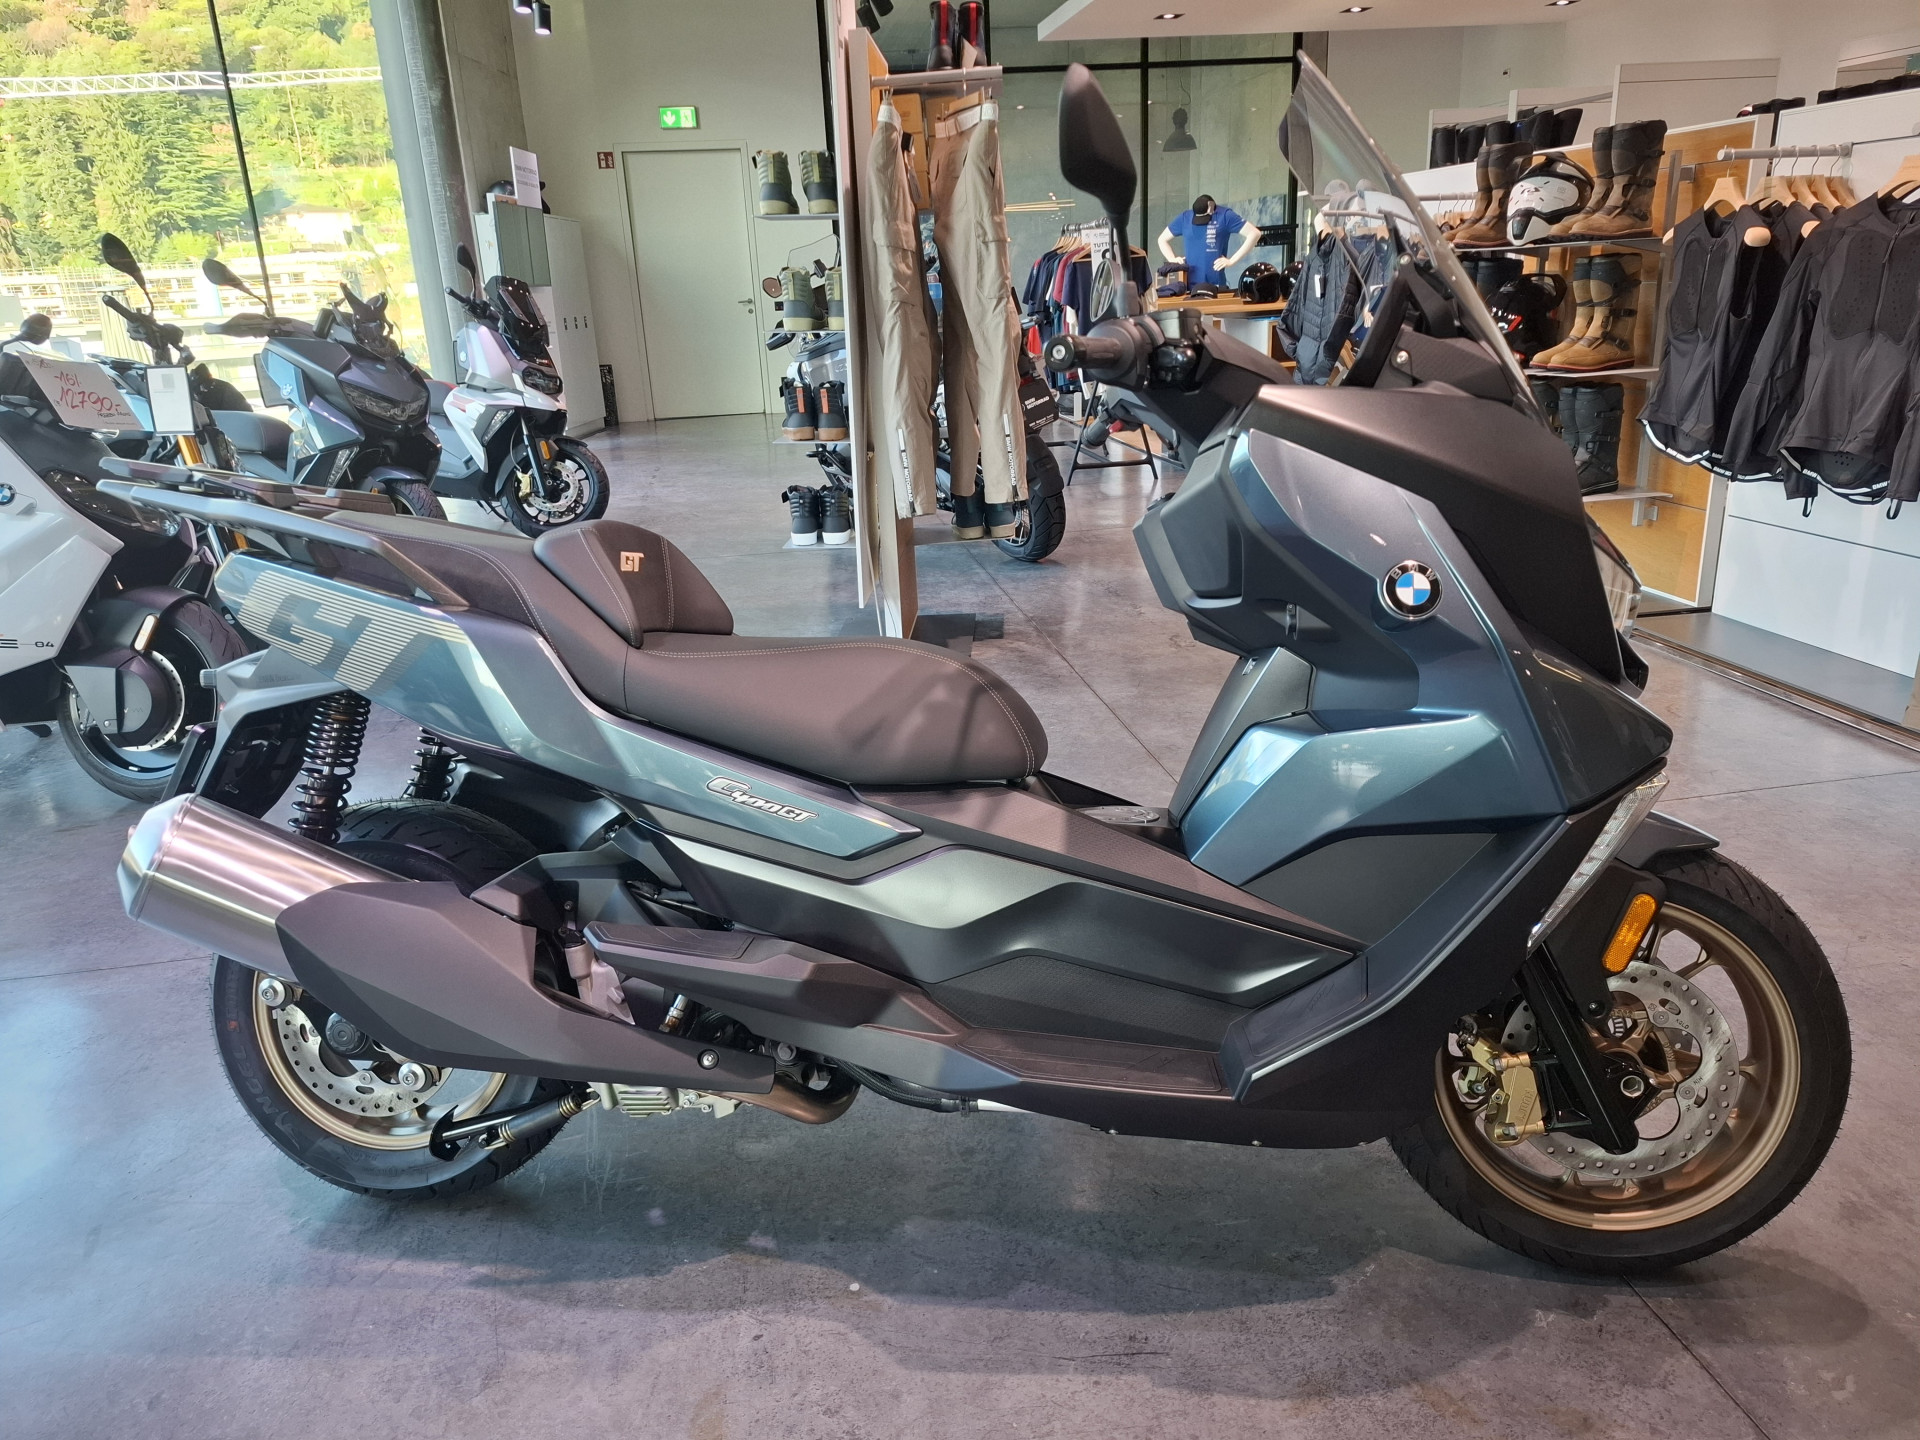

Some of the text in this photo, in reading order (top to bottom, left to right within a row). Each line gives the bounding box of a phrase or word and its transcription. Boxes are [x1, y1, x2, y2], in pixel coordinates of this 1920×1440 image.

[1008, 452, 1017, 486] MOTORRAD
[1802, 468, 1818, 478] BMW
[903, 468, 914, 502] MOTORRAD
[1872, 481, 1888, 490] BMW
[620, 551, 645, 572] GT
[1390, 563, 1437, 580] BMW
[237, 570, 471, 692] GT
[233, 1045, 300, 1150] ANGEL
